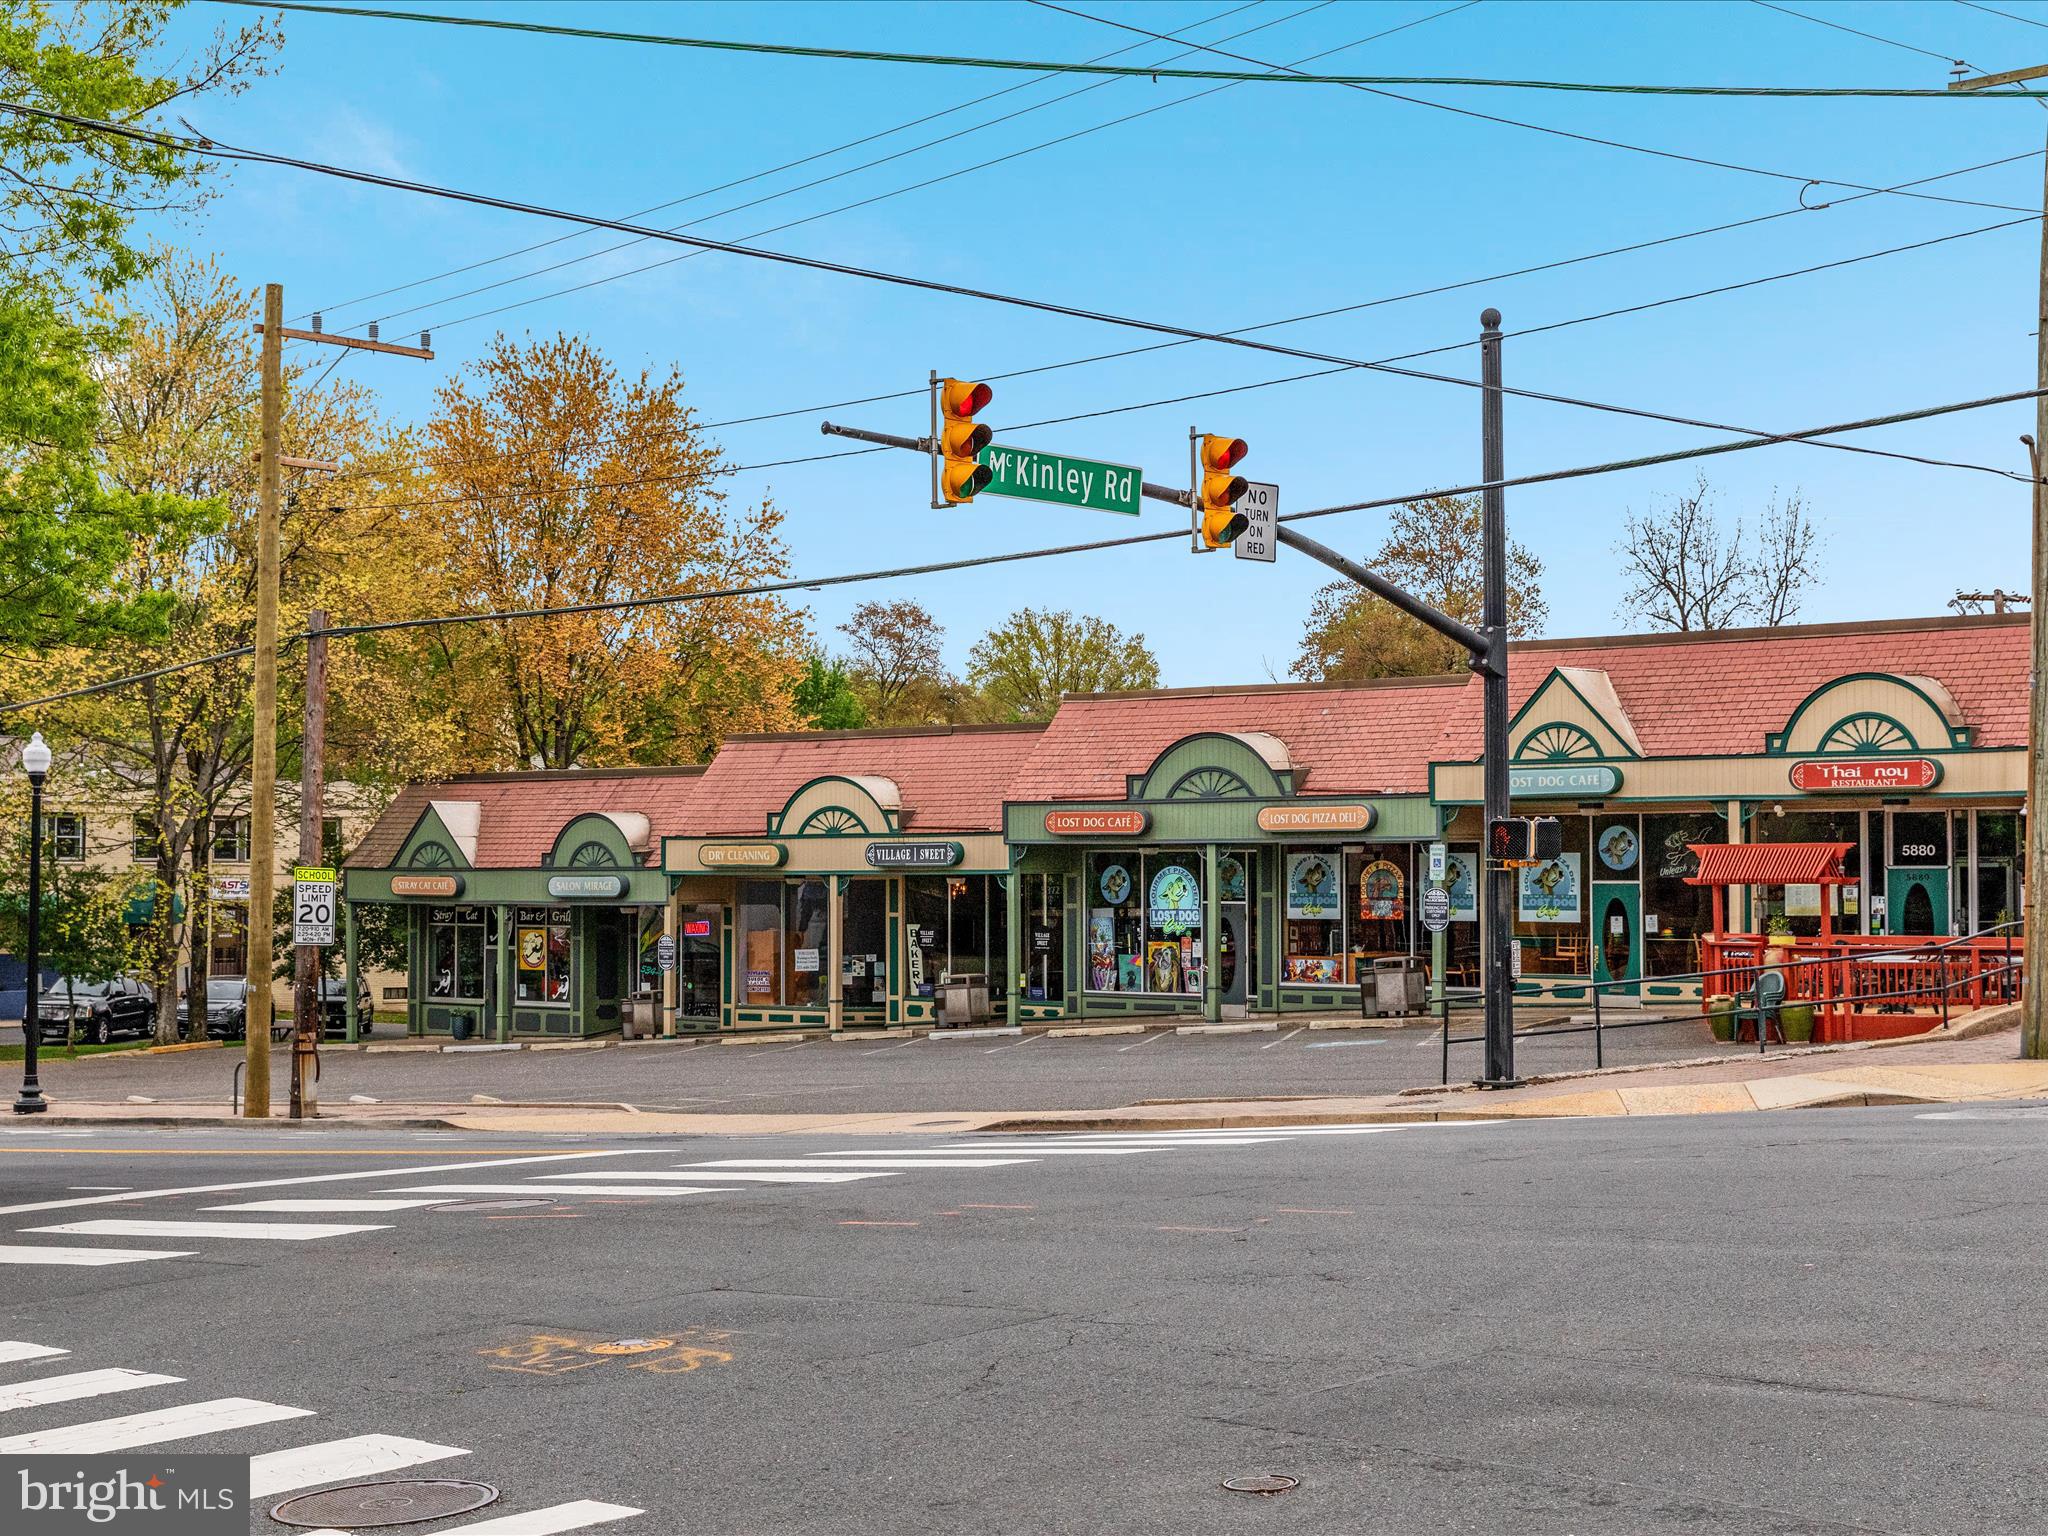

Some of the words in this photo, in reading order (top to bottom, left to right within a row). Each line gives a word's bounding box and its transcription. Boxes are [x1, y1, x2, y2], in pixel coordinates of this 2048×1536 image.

[1104, 469, 1133, 503] Rd
[1248, 489, 1267, 505] NO
[1245, 508, 1269, 523] TURN
[1249, 526, 1263, 538] ON
[1247, 541, 1265, 555] RED
[1817, 764, 1861, 778] Thai
[1875, 767, 1908, 780] noy
[1510, 777, 1533, 788] OST
[1538, 775, 1565, 787] DOG
[1569, 774, 1600, 786] CAFE
[1831, 778, 1898, 788] RESTAURANT
[1057, 817, 1081, 828] LOST
[1083, 817, 1105, 828] DOG
[1107, 814, 1132, 828] CAFÉ
[1271, 814, 1290, 825] LOST
[1291, 813, 1310, 824] DOG
[1312, 812, 1337, 824] PIZZA
[1339, 811, 1357, 823] DELI
[708, 850, 725, 861] DRY
[727, 850, 770, 861] CLEANING
[876, 848, 911, 861] VILLAGE
[919, 848, 946, 860] SWEET
[1902, 844, 1936, 857] 5880
[297, 870, 332, 880] SCHOOL
[1660, 864, 1687, 876] Unleash
[298, 884, 332, 894] SPEED
[398, 881, 418, 890] STRAY
[418, 881, 431, 890] CAT
[556, 881, 582, 891] SALON
[583, 881, 612, 891] MIRAGE
[301, 893, 328, 903] LIMIT
[298, 904, 331, 924] 20
[433, 910, 454, 922] Stray
[466, 910, 479, 920] Cat
[520, 911, 534, 921] Bar
[552, 910, 571, 922] Grill
[1151, 910, 1175, 921] LOST
[1178, 910, 1200, 921] DOG
[909, 928, 921, 989] BAKERY
